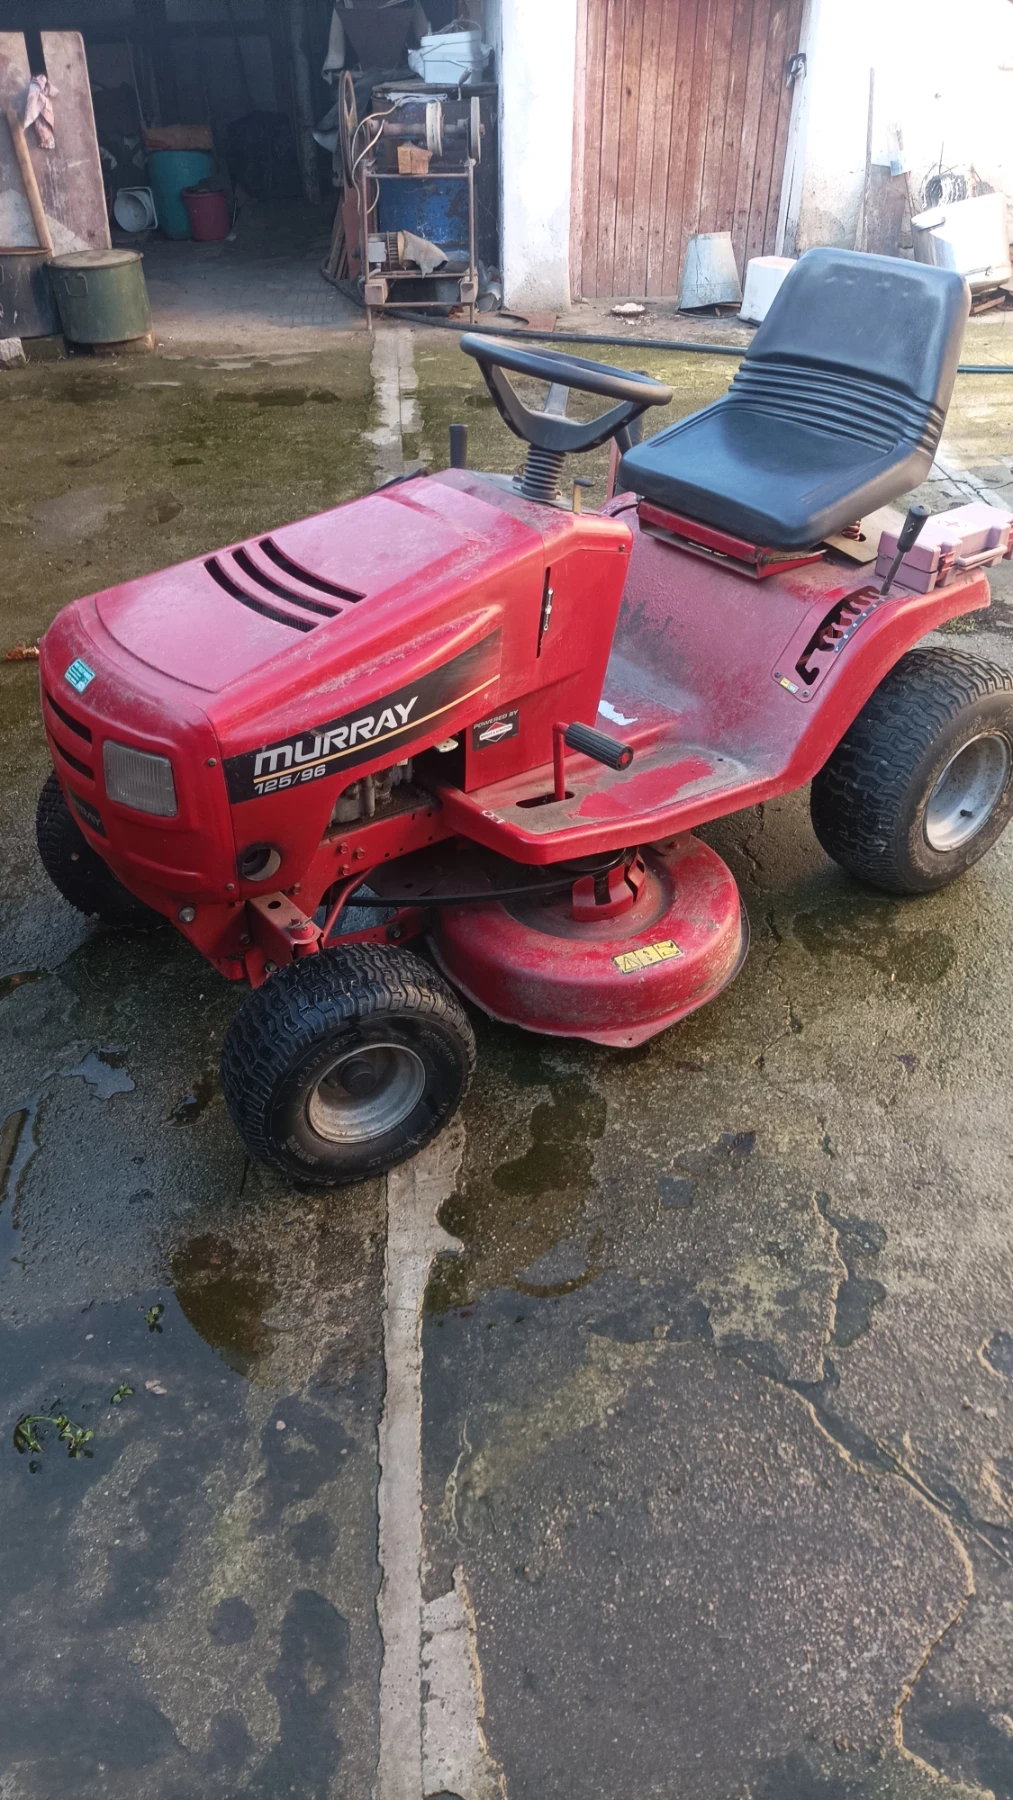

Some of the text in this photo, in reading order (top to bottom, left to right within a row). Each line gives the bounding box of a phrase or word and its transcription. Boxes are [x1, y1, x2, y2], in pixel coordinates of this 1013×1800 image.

[473, 709, 519, 729] POWERED BY
[253, 696, 418, 776] MURRAY
[254, 764, 326, 795] 125/96
